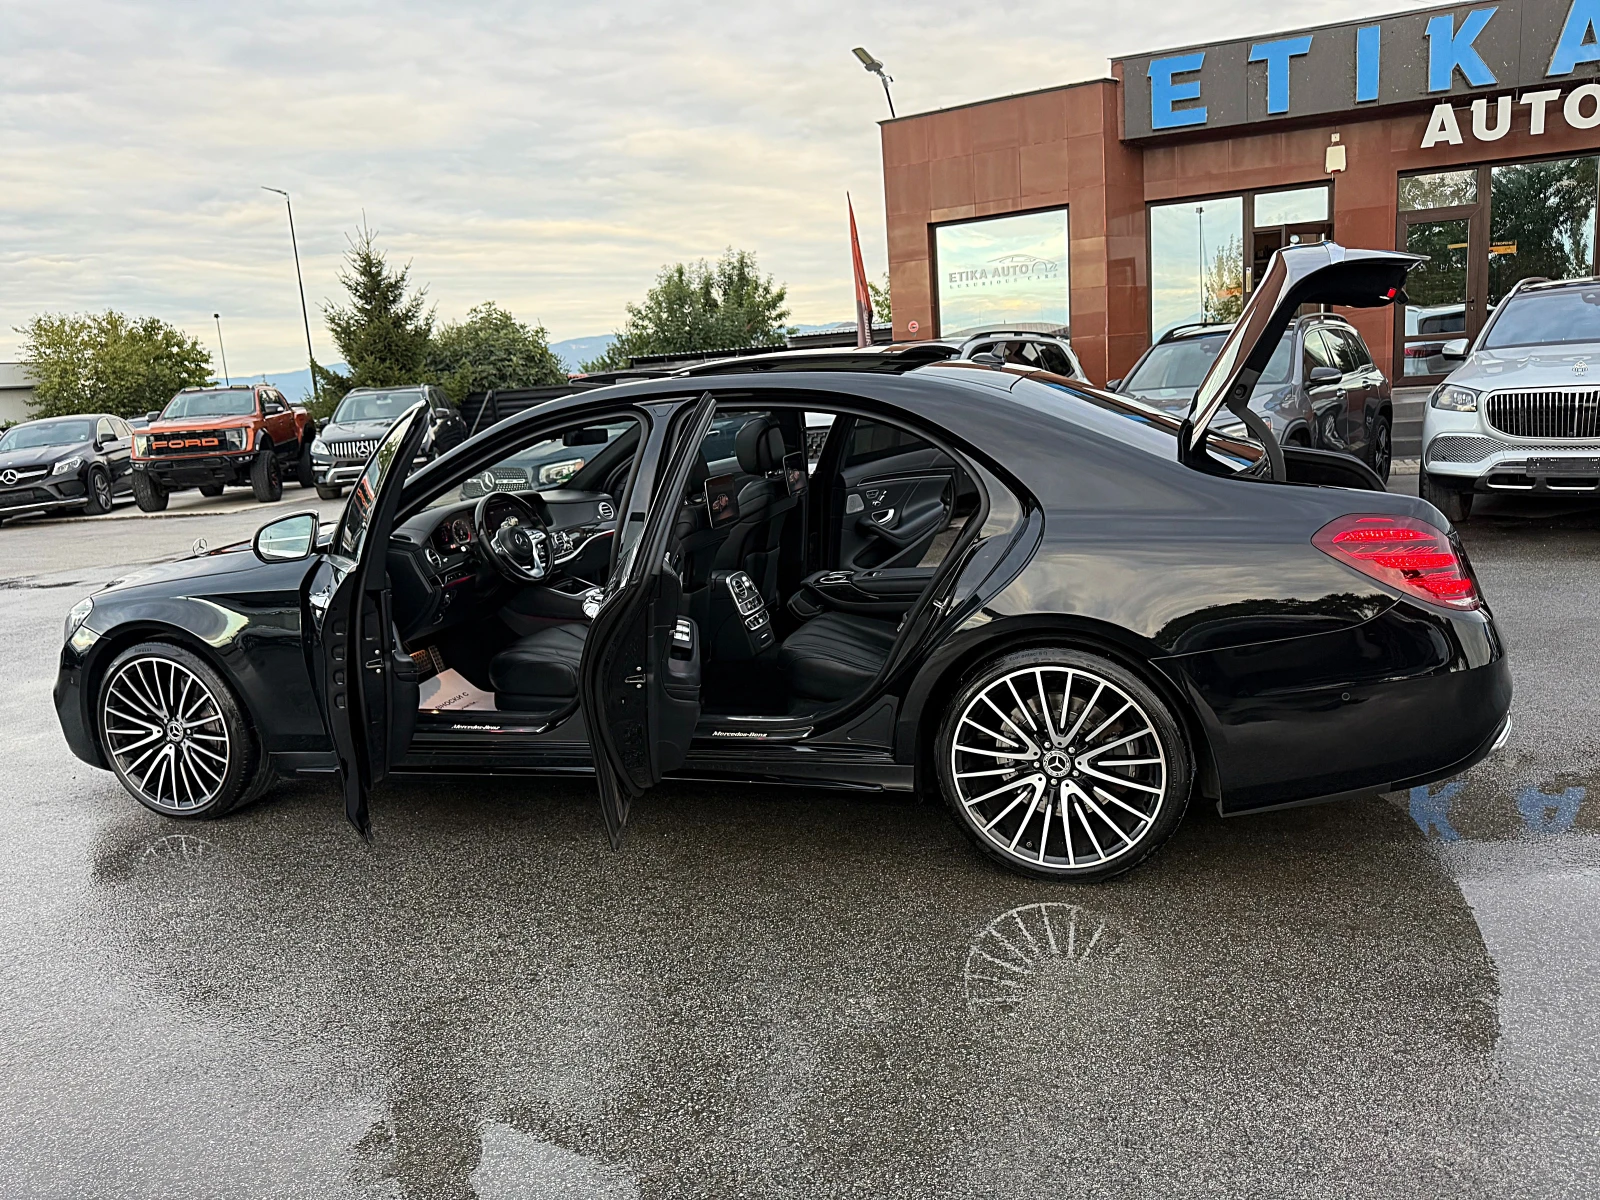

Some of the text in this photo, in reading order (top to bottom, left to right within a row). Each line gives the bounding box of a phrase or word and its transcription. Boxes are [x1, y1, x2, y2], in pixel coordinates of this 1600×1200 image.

[1147, 0, 1600, 130] ETIKA
[1420, 83, 1600, 149] AUTO
[949, 264, 1030, 284] ETIKA AUTO
[949, 273, 1058, 289] LUXURIOUS CARS
[151, 437, 219, 450] FORD
